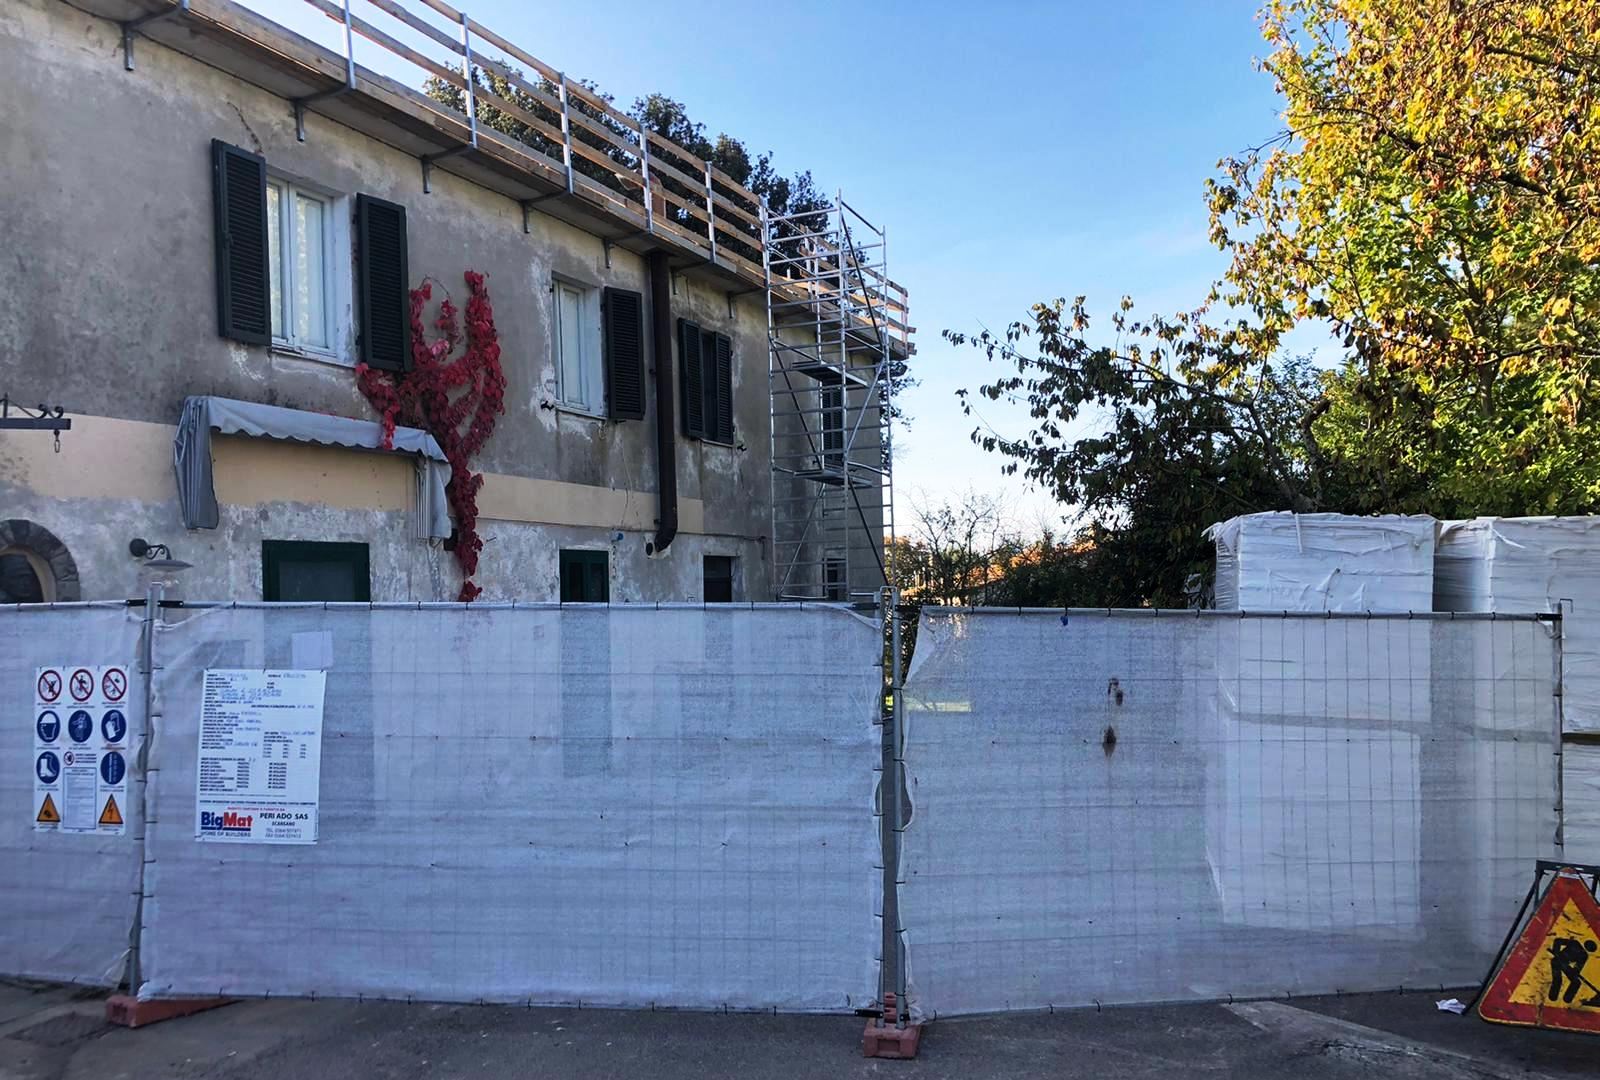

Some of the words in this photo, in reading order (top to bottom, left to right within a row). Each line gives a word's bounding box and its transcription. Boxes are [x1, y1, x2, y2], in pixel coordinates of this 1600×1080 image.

[201, 811, 253, 830] BigMat
[260, 812, 275, 820] PERI
[276, 812, 293, 820] ADO
